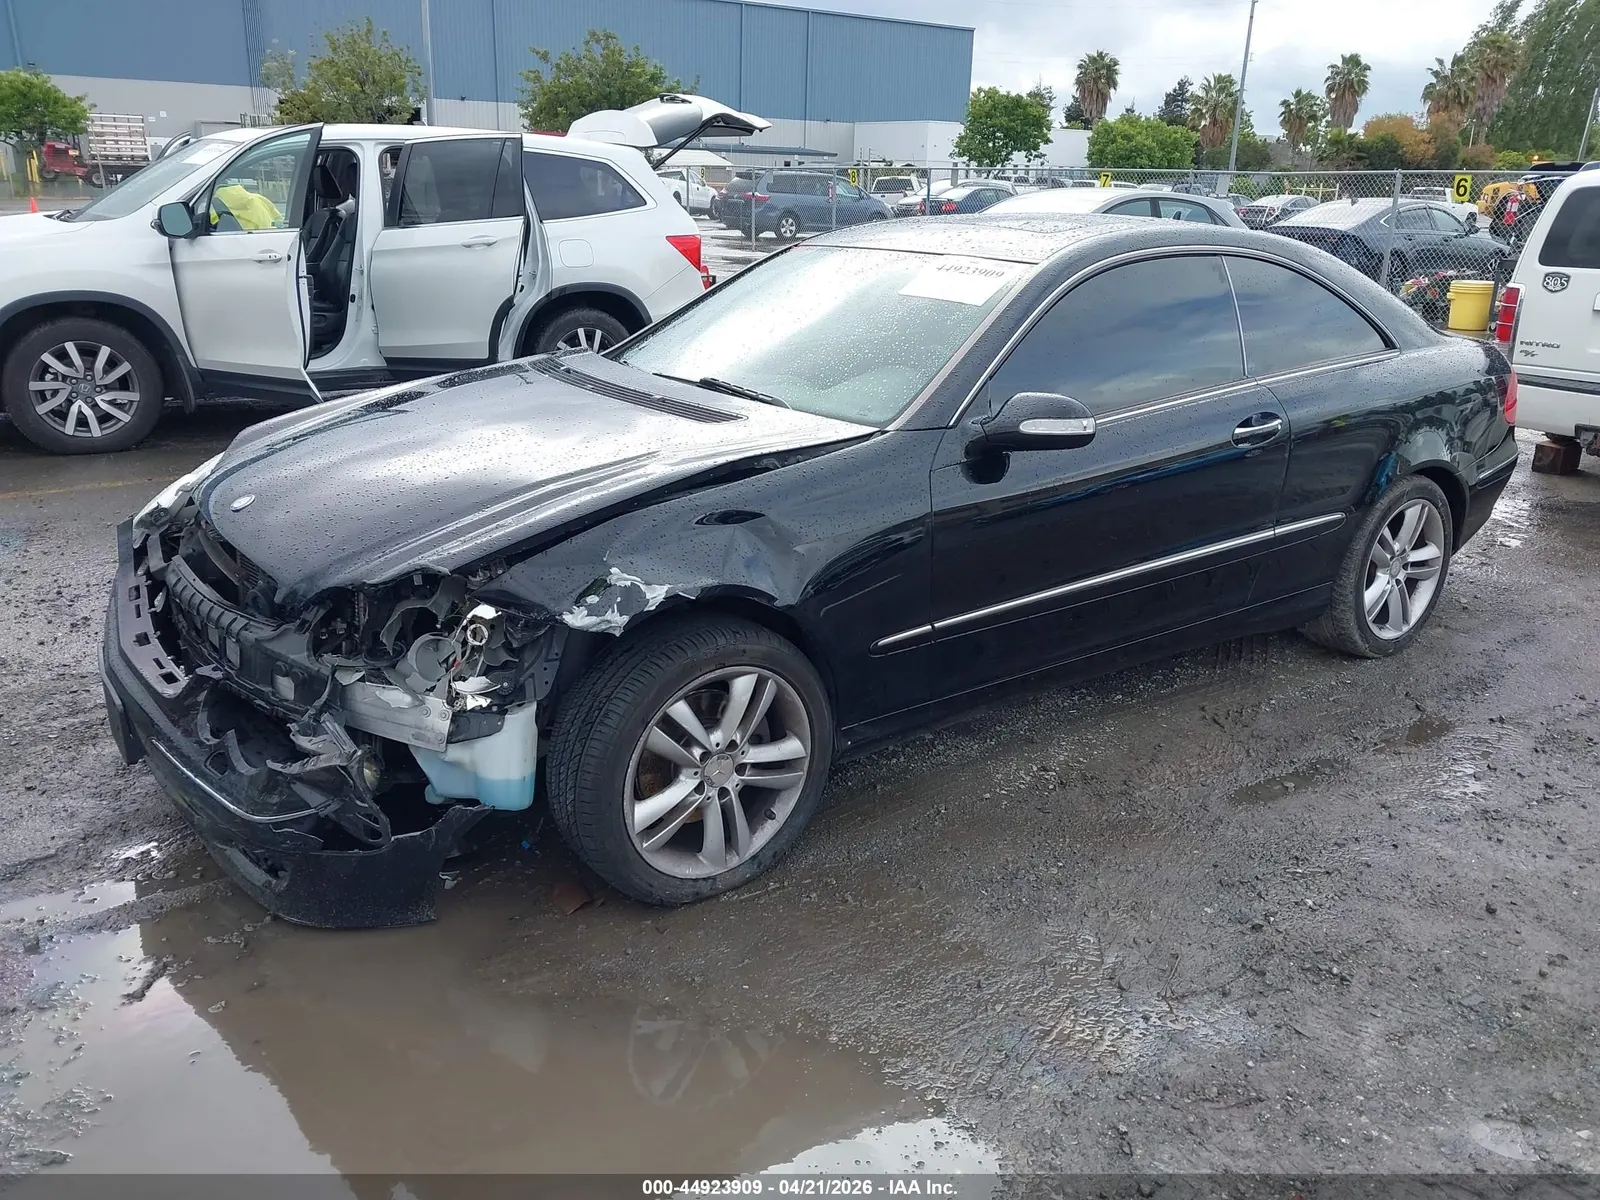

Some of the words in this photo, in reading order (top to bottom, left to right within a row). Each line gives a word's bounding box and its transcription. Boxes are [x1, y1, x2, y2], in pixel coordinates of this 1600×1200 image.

[851, 171, 856, 183] 8
[1102, 174, 1110, 187] 7
[1456, 178, 1468, 197] 6
[936, 264, 1005, 277] 44923909
[1543, 275, 1569, 287] 805
[1519, 340, 1561, 349] NITRO
